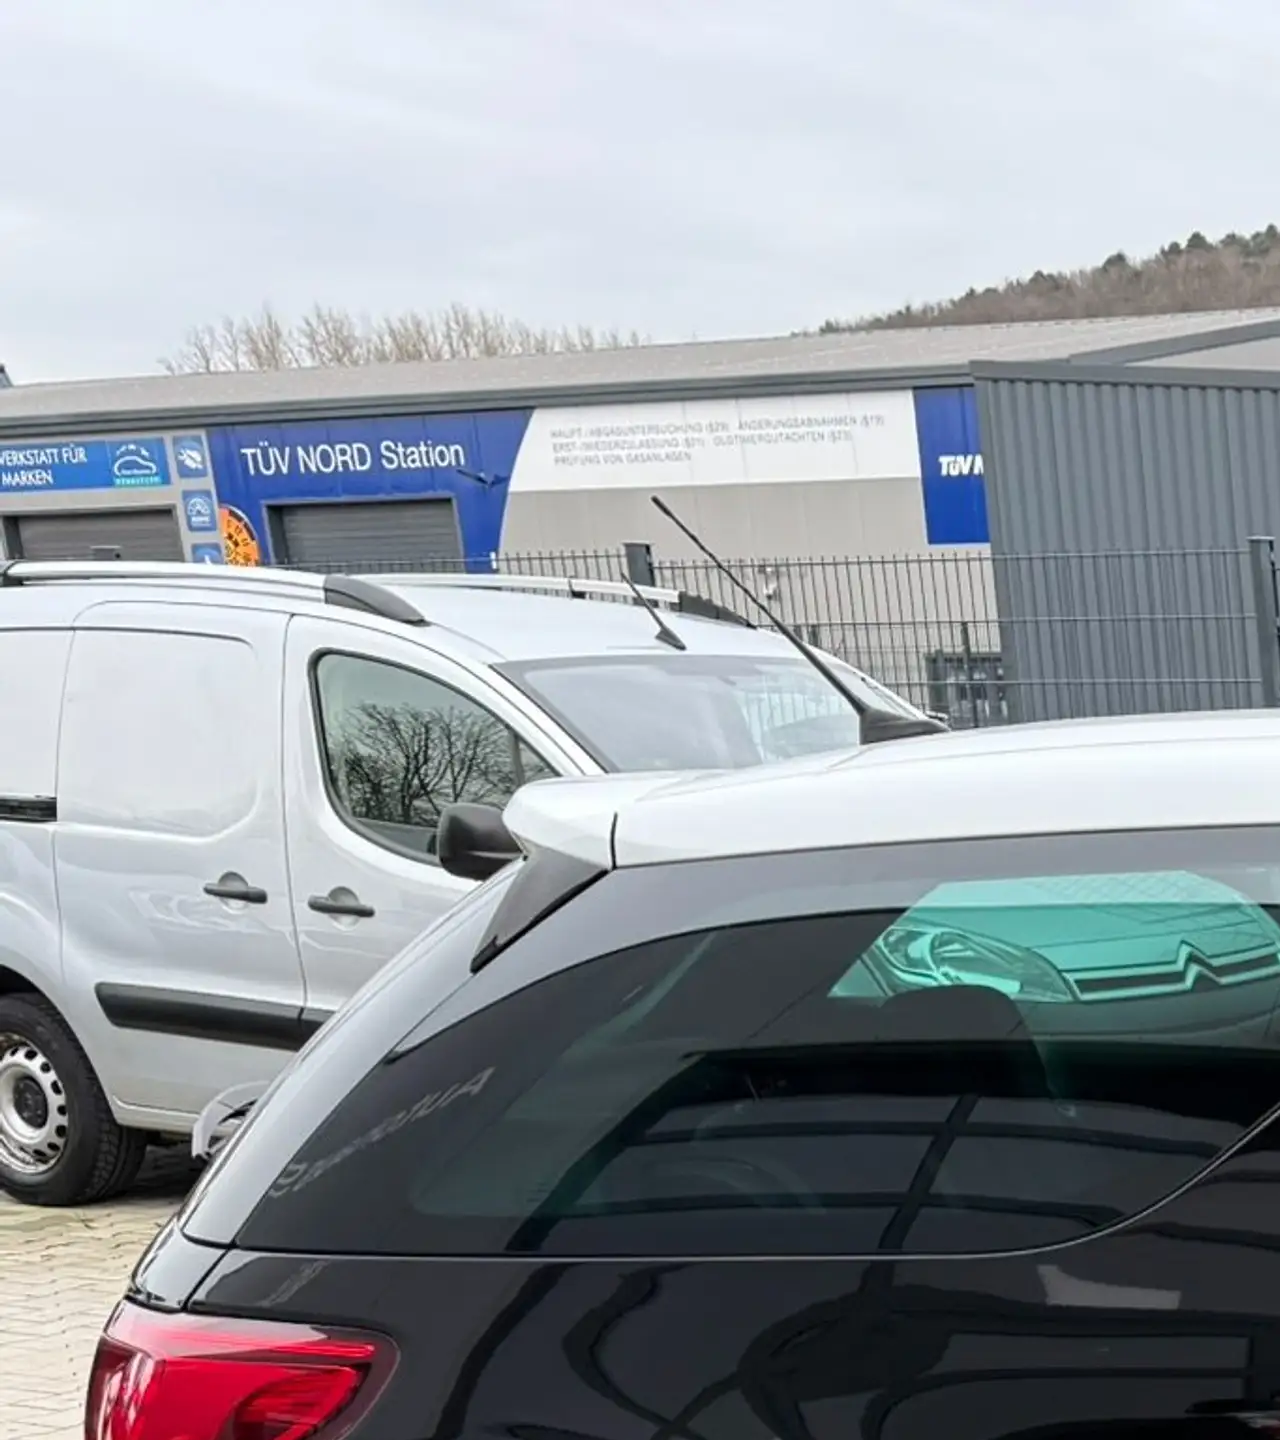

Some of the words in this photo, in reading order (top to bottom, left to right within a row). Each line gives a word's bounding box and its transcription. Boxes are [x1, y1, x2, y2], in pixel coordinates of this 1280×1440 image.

[62, 443, 88, 464] FÜR
[240, 441, 290, 476] TÜV
[297, 442, 372, 474] NORD
[380, 440, 465, 470] Station
[2, 469, 54, 487] MARKEN
